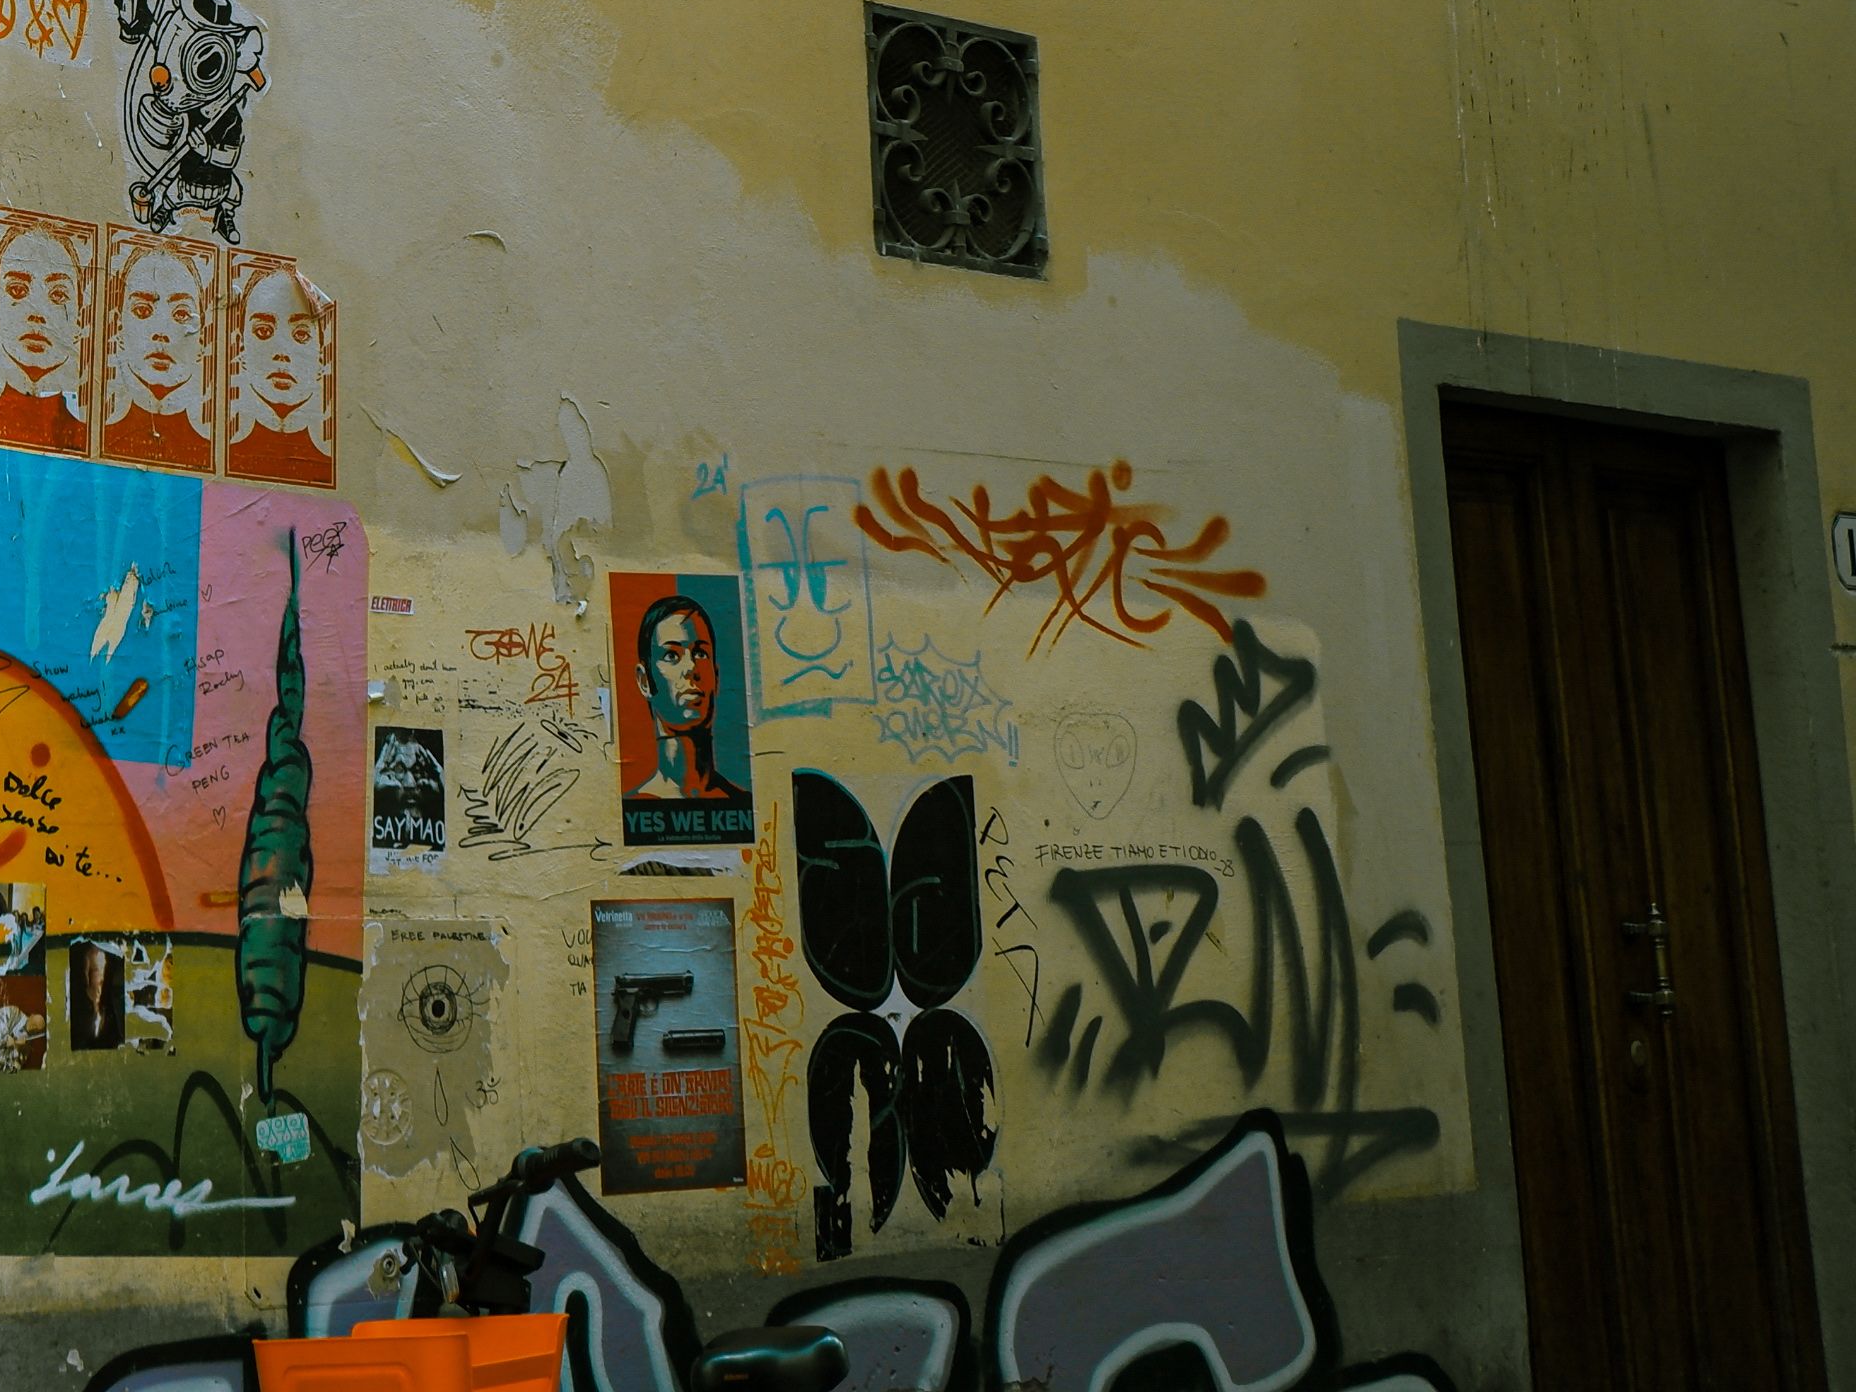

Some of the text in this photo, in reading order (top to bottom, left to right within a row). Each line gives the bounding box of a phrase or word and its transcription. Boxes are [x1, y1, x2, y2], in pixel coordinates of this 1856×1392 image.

[191, 766, 231, 795] PENG
[624, 809, 753, 834] YES WE KEN
[1034, 844, 1105, 868] FIRENZE
[390, 929, 425, 943] FREE
